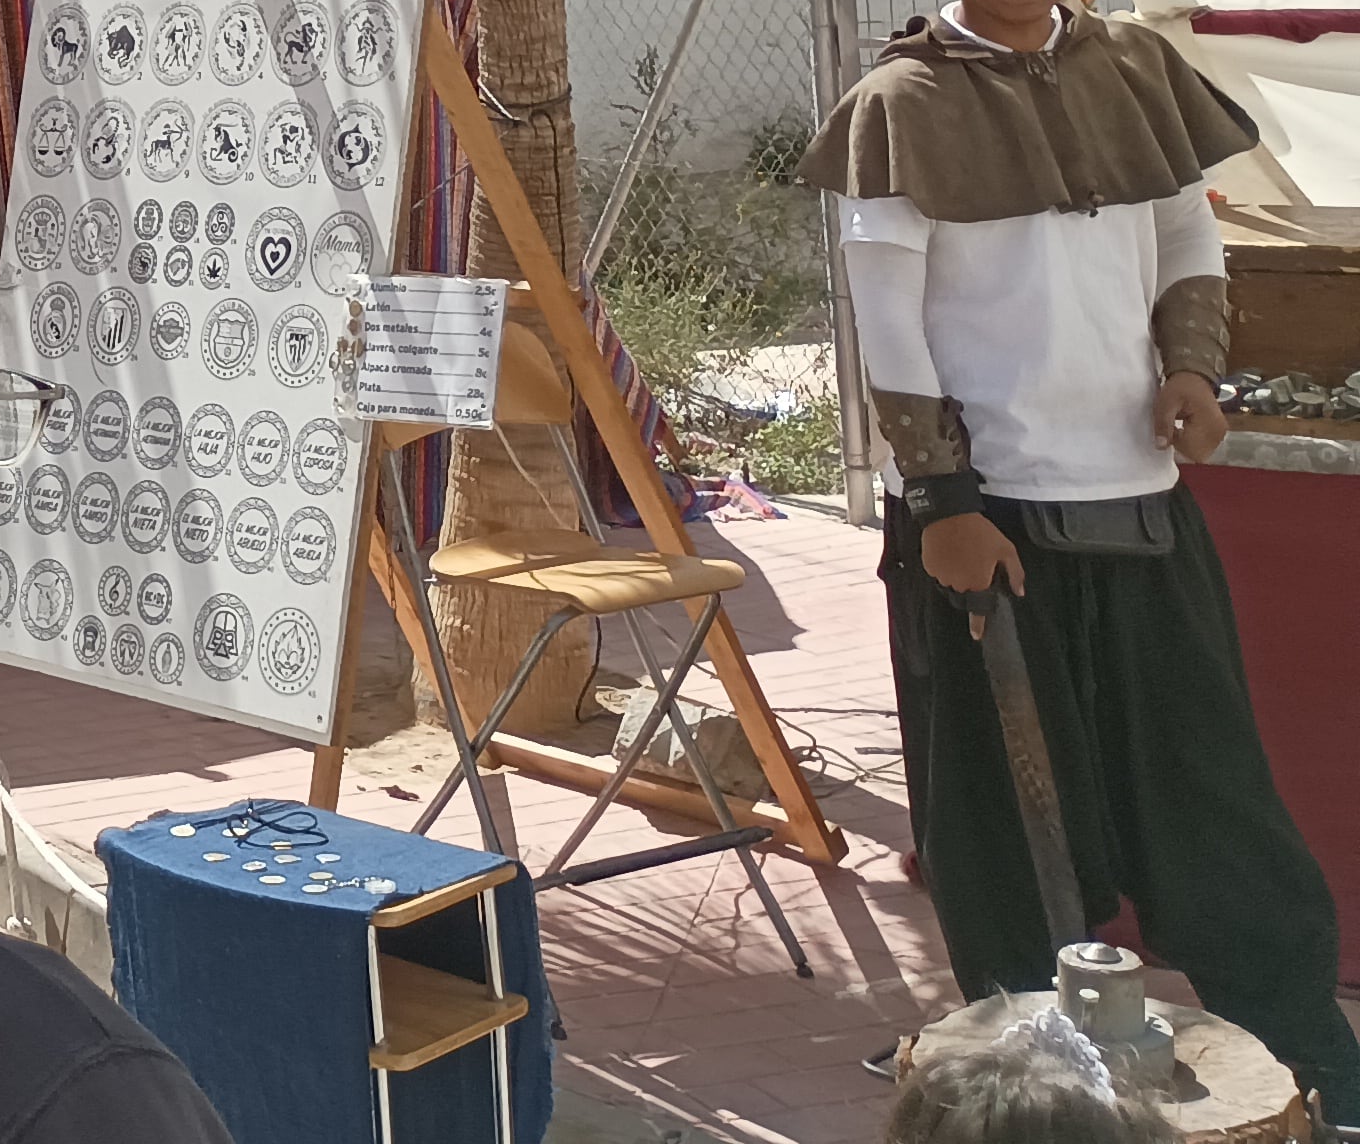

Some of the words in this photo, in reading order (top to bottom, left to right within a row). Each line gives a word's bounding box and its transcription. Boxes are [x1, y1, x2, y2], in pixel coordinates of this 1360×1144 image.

[365, 302, 391, 312] Latón
[364, 322, 381, 332] Dos
[382, 323, 419, 334] metales
[398, 344, 439, 356] colgante
[360, 362, 390, 373] Alpaca
[392, 364, 433, 376] cromada
[358, 381, 381, 392] Plata
[357, 401, 376, 414] Caja
[377, 405, 397, 415] para
[399, 406, 436, 417] moneda
[257, 437, 281, 449] MEJOR
[131, 516, 157, 531] NIETA
[183, 527, 210, 542] NIETO
